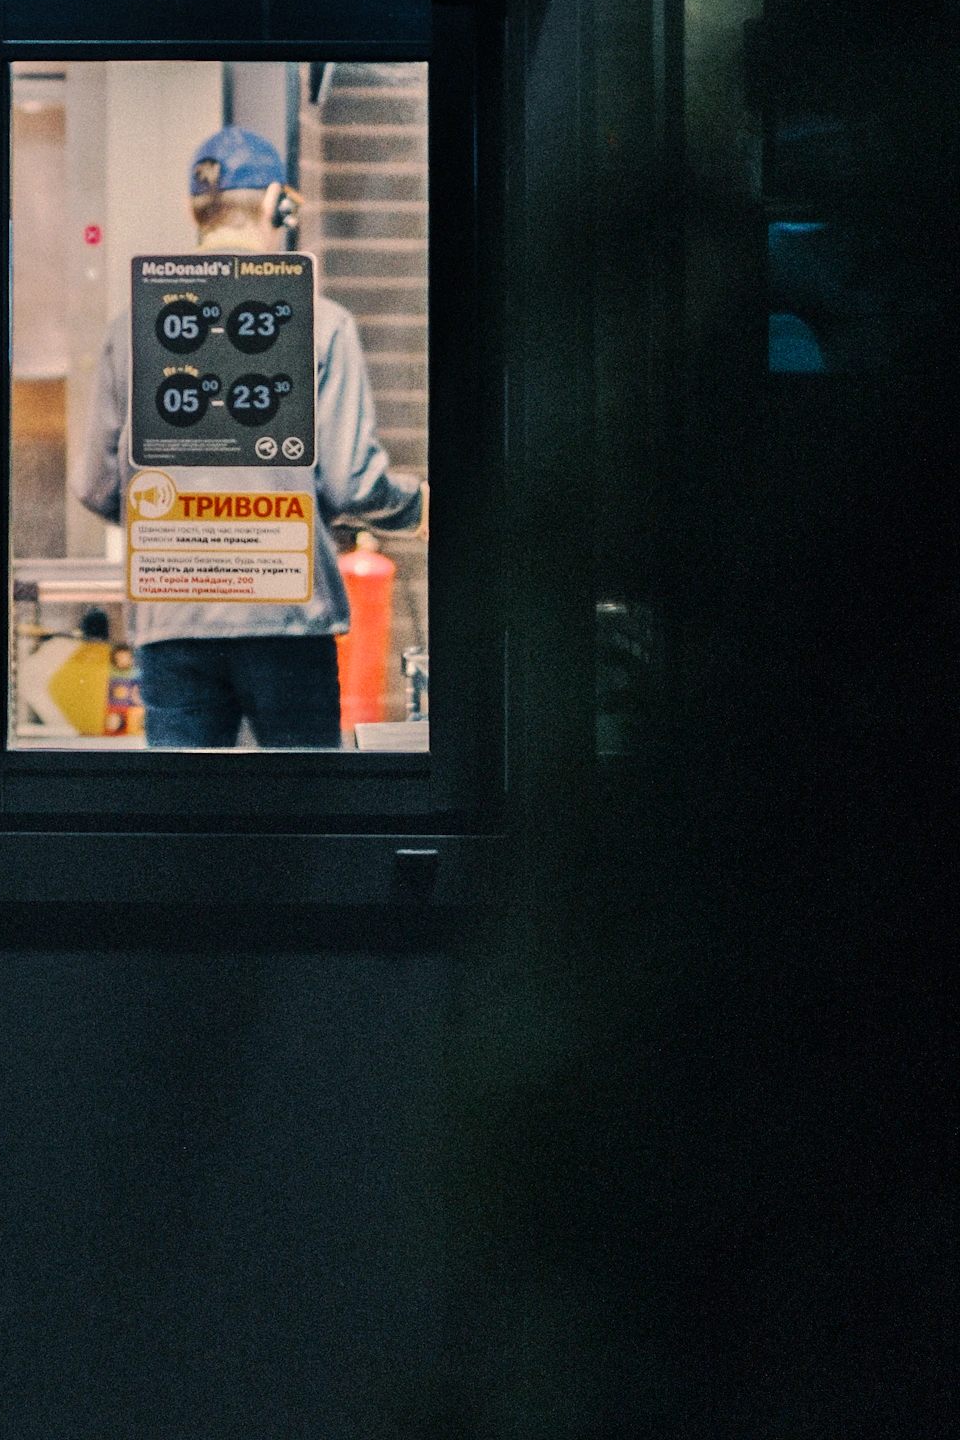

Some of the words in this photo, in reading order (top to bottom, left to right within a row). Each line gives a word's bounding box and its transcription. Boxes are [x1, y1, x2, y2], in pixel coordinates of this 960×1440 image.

[142, 262, 230, 276] McDonald's
[241, 262, 303, 276] McDrive
[163, 315, 199, 339] 05
[202, 307, 220, 318] 00
[238, 312, 275, 336] 23
[275, 305, 291, 316] 30
[163, 389, 199, 412] 05
[202, 380, 219, 391] 00
[233, 386, 271, 409] 23
[274, 381, 290, 393] 30
[179, 496, 304, 518] ТРИВОГА
[139, 565, 181, 574] пройдіть
[197, 565, 259, 574] найближчого
